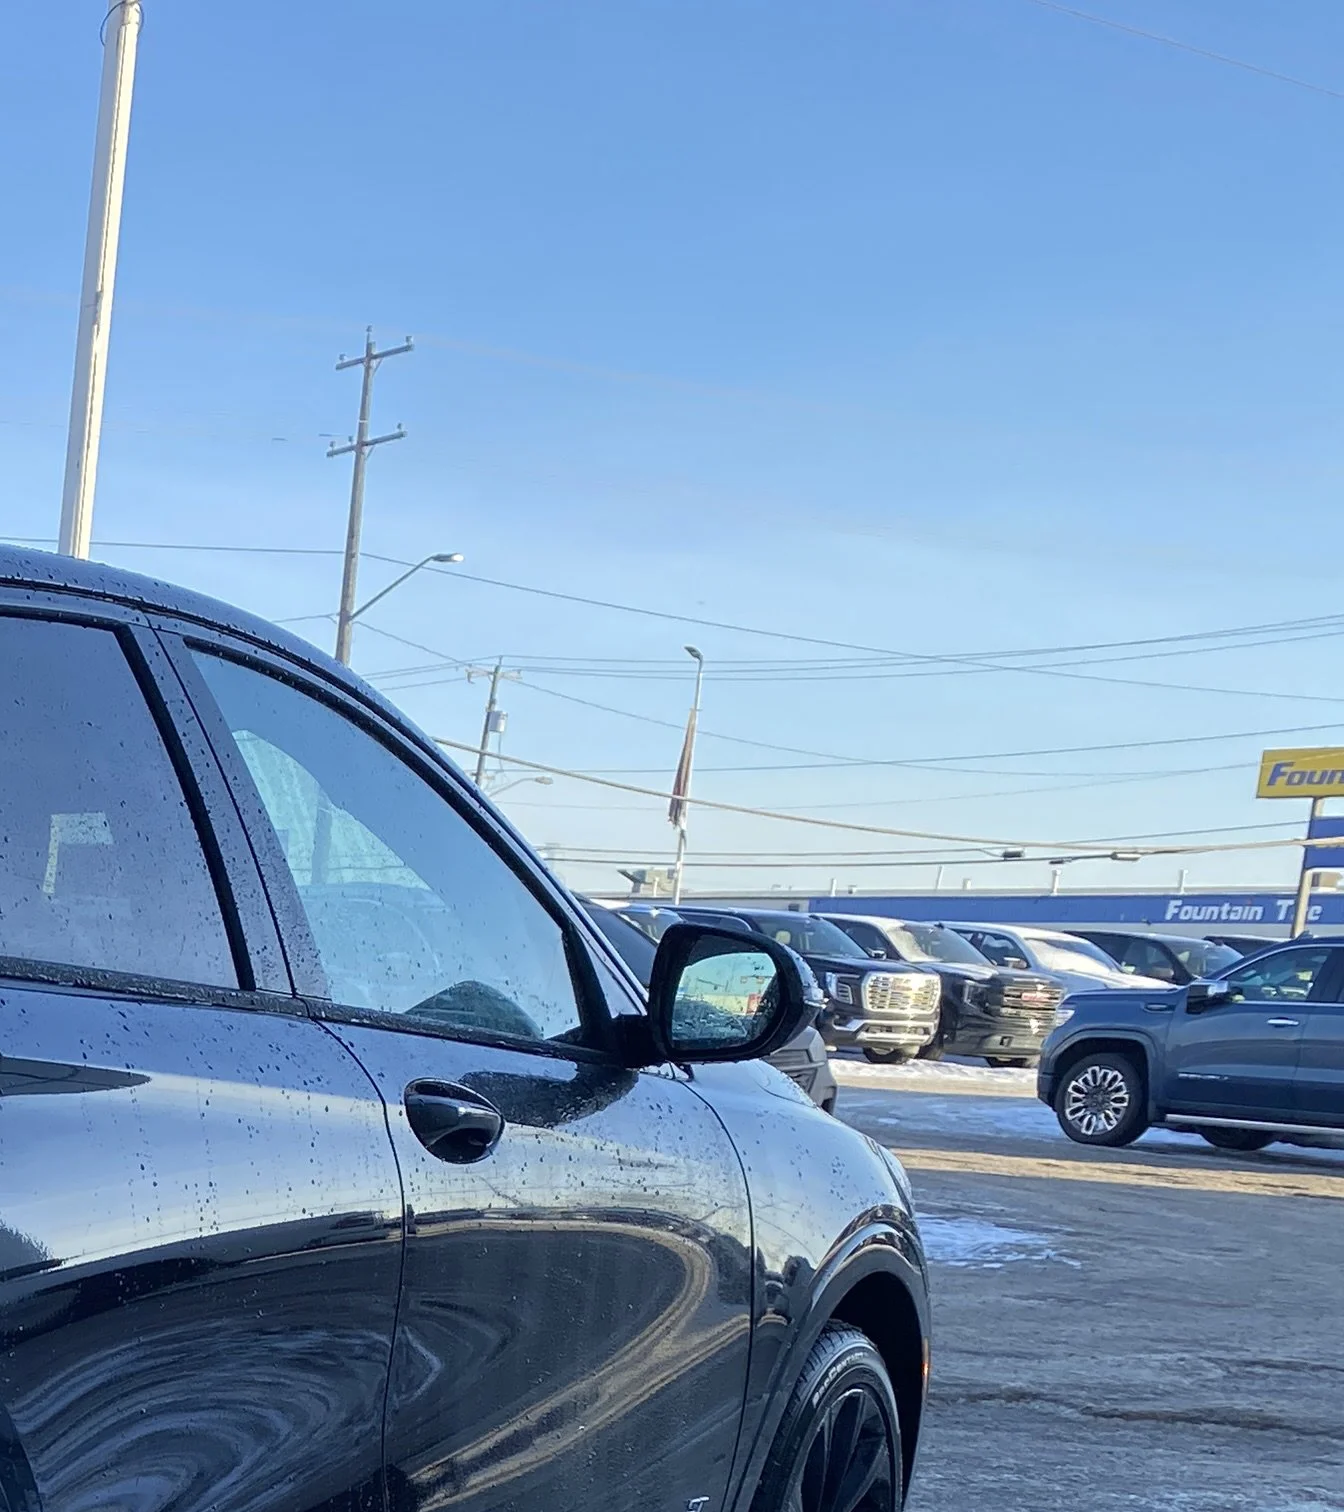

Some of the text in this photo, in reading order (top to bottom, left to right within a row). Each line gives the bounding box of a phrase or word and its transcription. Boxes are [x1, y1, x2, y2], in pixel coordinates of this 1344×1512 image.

[1266, 761, 1344, 786] Foun
[1164, 899, 1323, 921] Fountain Te
